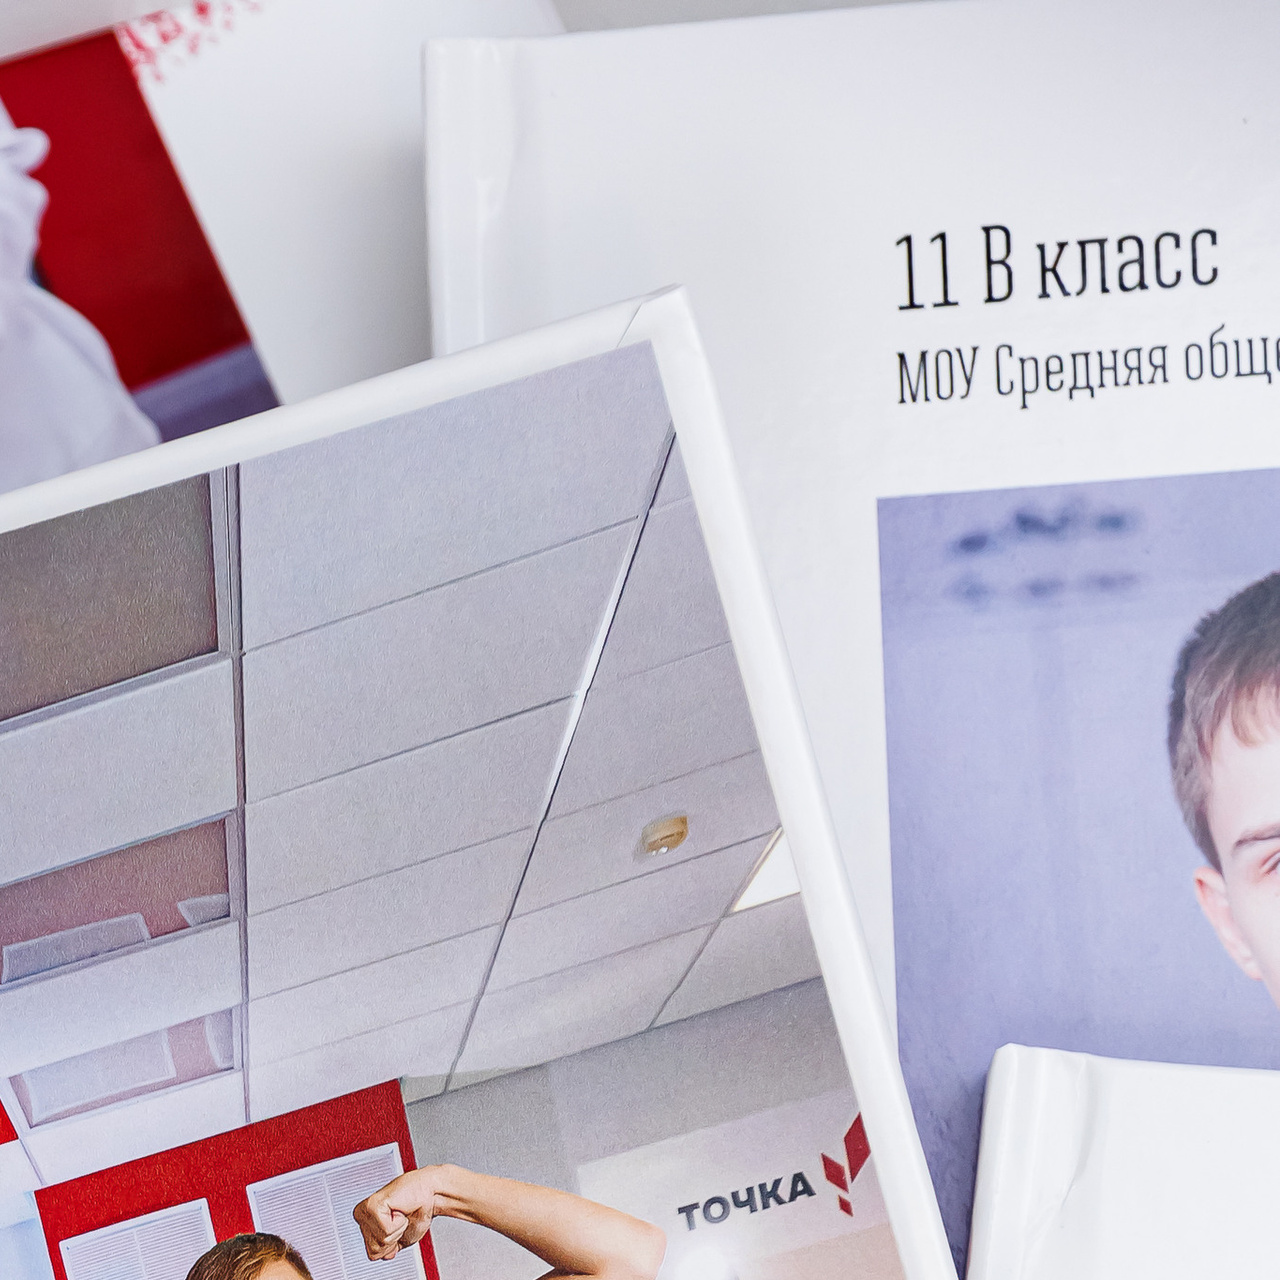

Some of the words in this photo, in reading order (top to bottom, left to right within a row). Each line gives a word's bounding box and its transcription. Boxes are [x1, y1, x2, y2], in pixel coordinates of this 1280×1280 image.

[895, 231, 959, 311] 11
[981, 224, 1014, 304] В
[1036, 228, 1219, 299] класс
[896, 345, 980, 404] МОУ
[995, 343, 1169, 410] Средняя
[1185, 323, 1280, 385] общ
[677, 1171, 817, 1231] ТОЧКА
